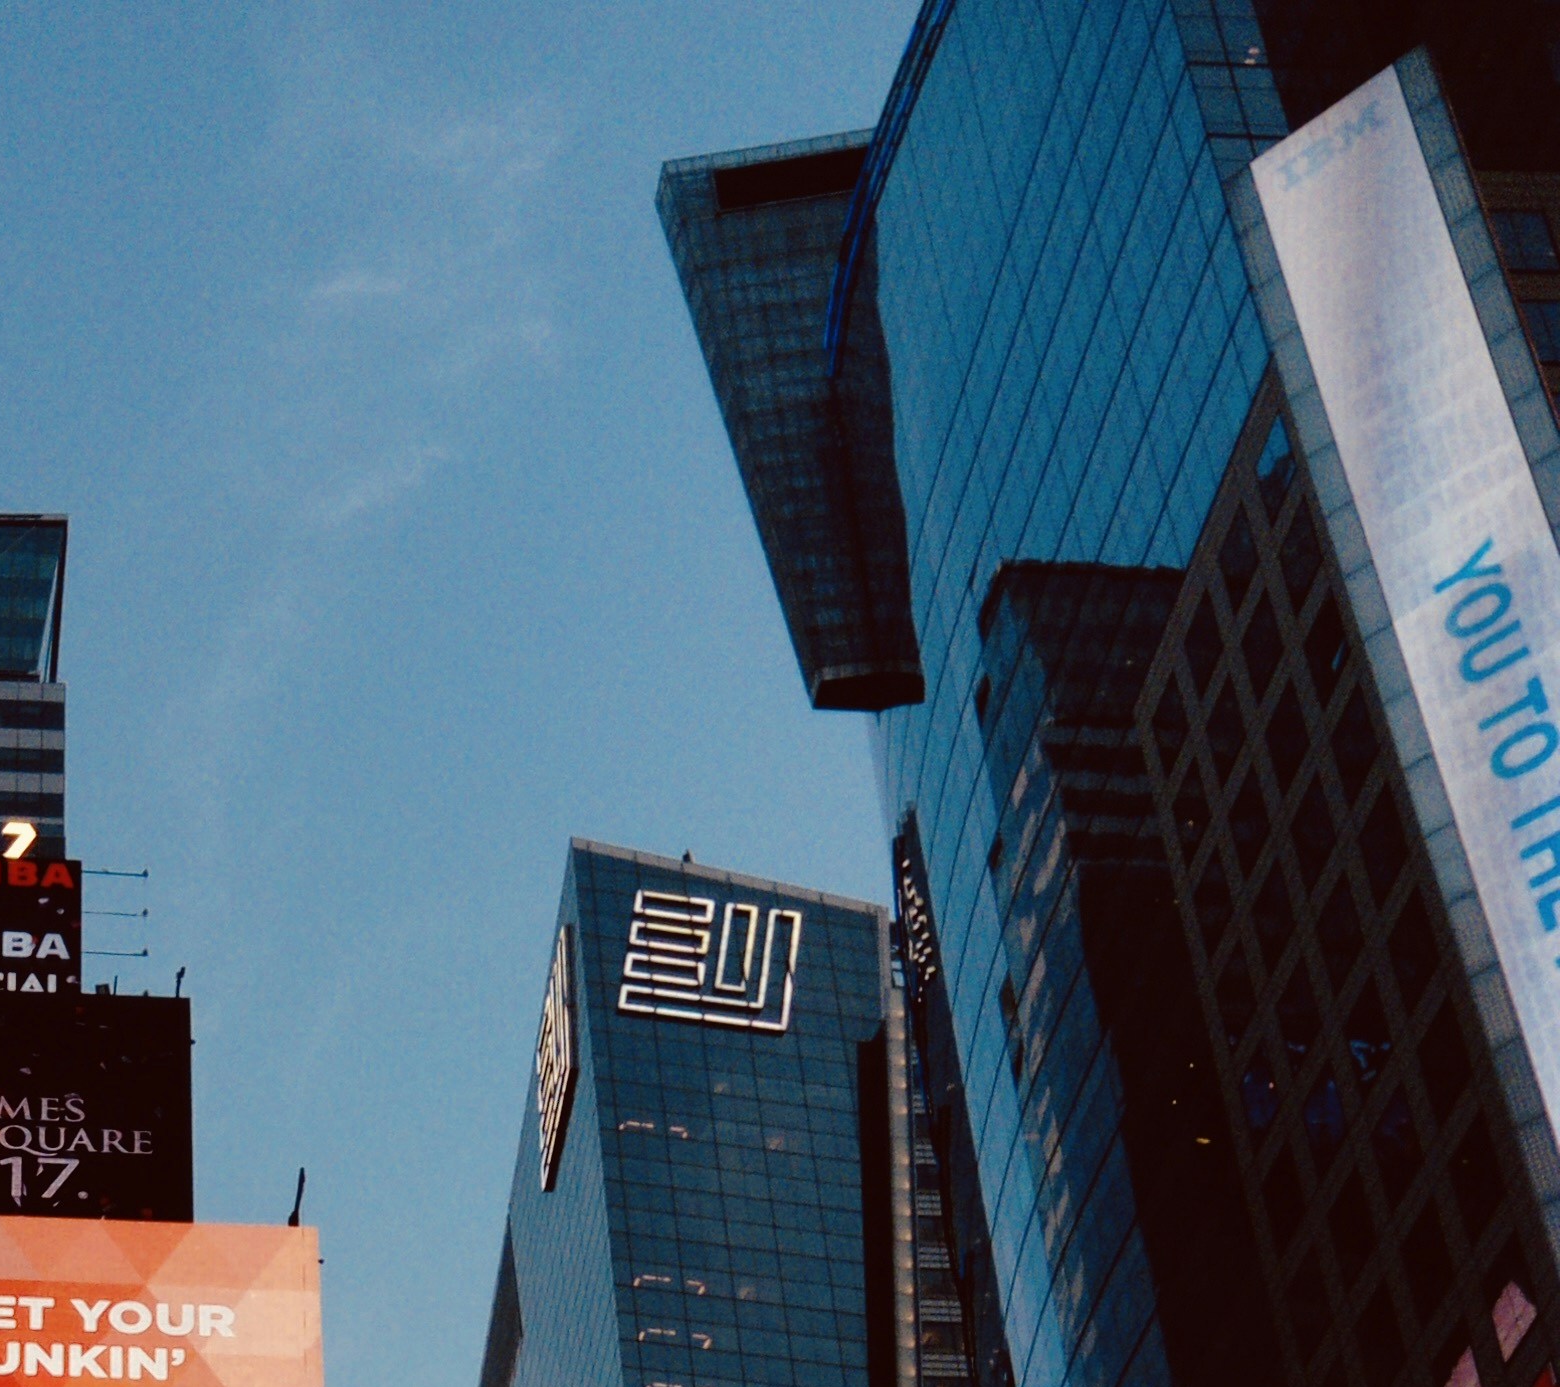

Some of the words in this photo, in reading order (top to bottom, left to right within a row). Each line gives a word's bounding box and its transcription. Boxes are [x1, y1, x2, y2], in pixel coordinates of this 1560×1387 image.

[1433, 537, 1532, 686] YOU
[1478, 673, 1560, 781] TO
[71, 1297, 236, 1340] YOUR
